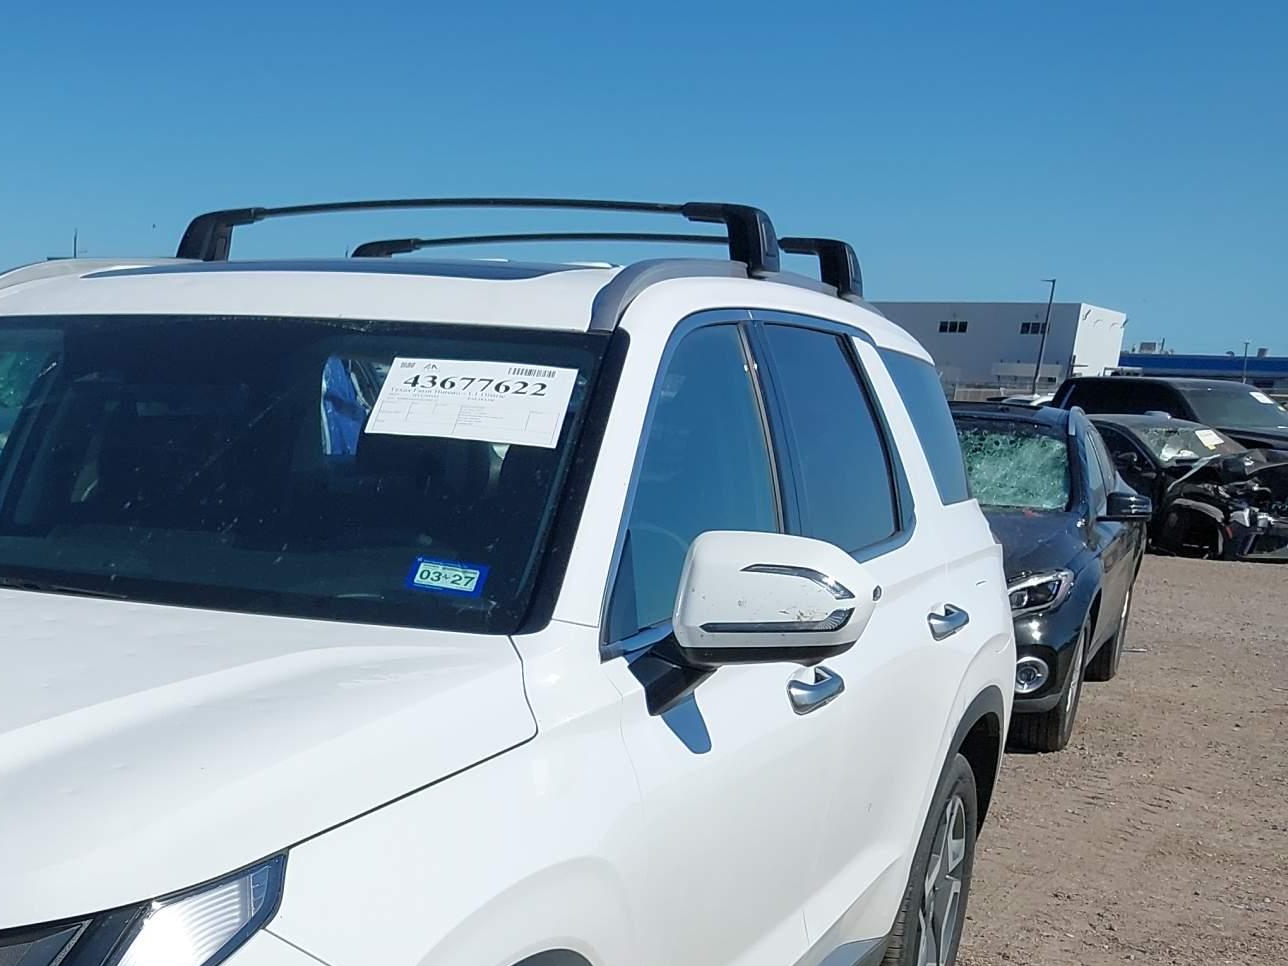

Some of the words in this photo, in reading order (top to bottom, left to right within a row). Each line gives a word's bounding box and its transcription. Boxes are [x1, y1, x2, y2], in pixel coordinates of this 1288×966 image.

[403, 374, 548, 397] 43677622
[419, 569, 443, 582] 03
[450, 573, 476, 587] 27
